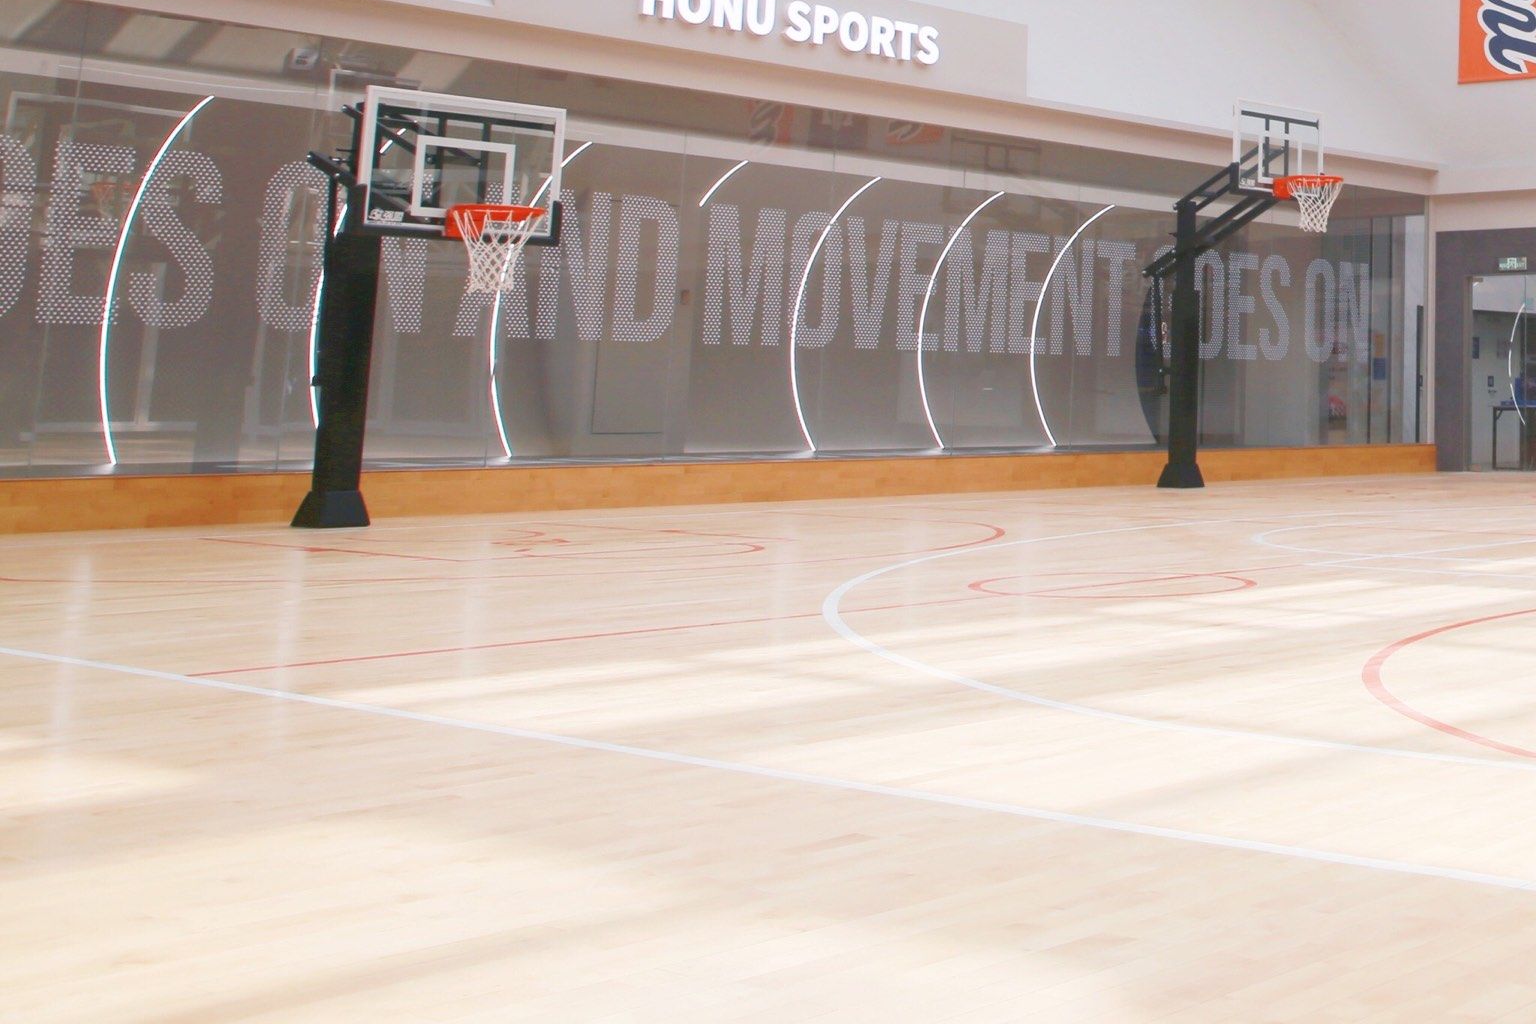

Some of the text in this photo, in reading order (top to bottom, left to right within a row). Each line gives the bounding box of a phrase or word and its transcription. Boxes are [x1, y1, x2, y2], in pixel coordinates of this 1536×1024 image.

[783, 0, 940, 65] SPORTS
[452, 181, 680, 342] AND
[702, 203, 1136, 356] MOVEMENT
[1304, 258, 1369, 363] ON
